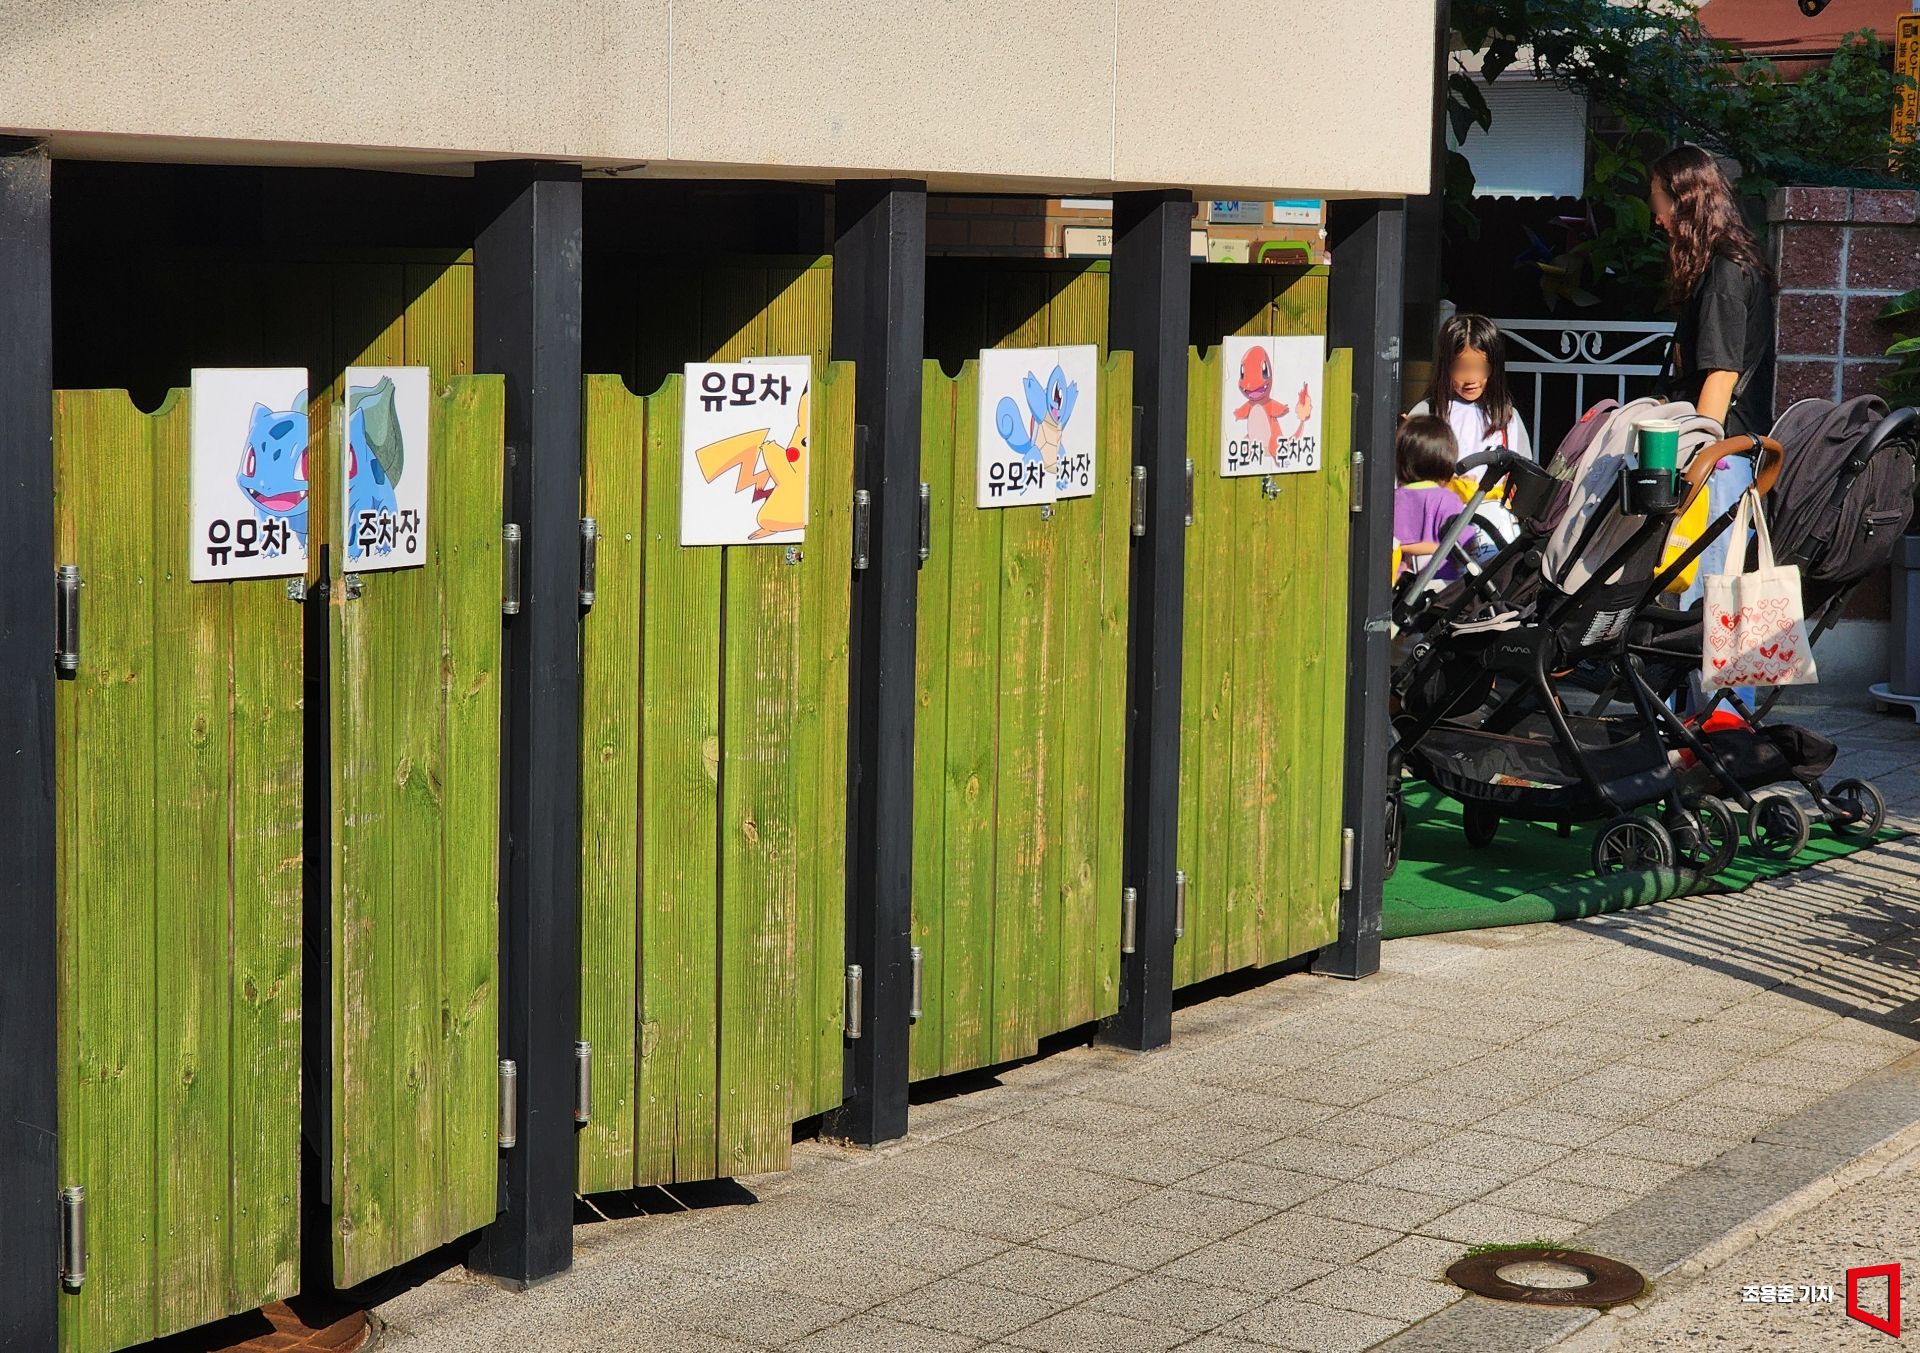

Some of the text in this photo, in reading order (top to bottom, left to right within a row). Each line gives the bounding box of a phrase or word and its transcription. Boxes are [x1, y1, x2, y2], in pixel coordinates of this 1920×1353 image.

[699, 371, 792, 412] 유모차
[1227, 435, 1316, 472] 유모차 주차장
[988, 461, 1046, 498] 유모차
[206, 508, 421, 567] 유모차 주차장
